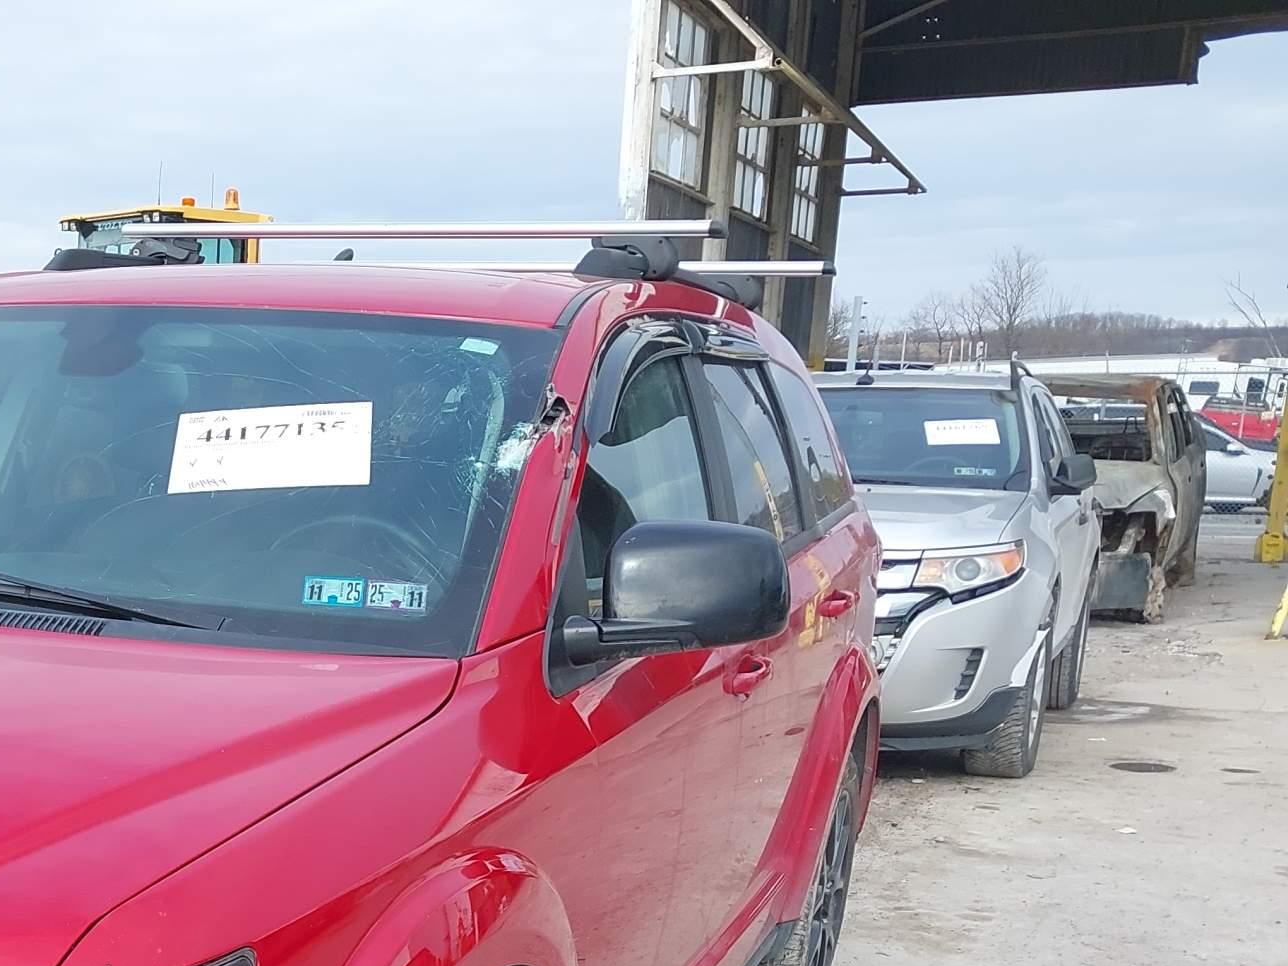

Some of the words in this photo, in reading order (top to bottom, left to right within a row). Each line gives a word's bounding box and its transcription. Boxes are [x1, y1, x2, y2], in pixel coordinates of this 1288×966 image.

[308, 584, 323, 601] 11
[346, 582, 361, 601] 25
[370, 584, 384, 603] 25
[408, 591, 423, 608] 11
